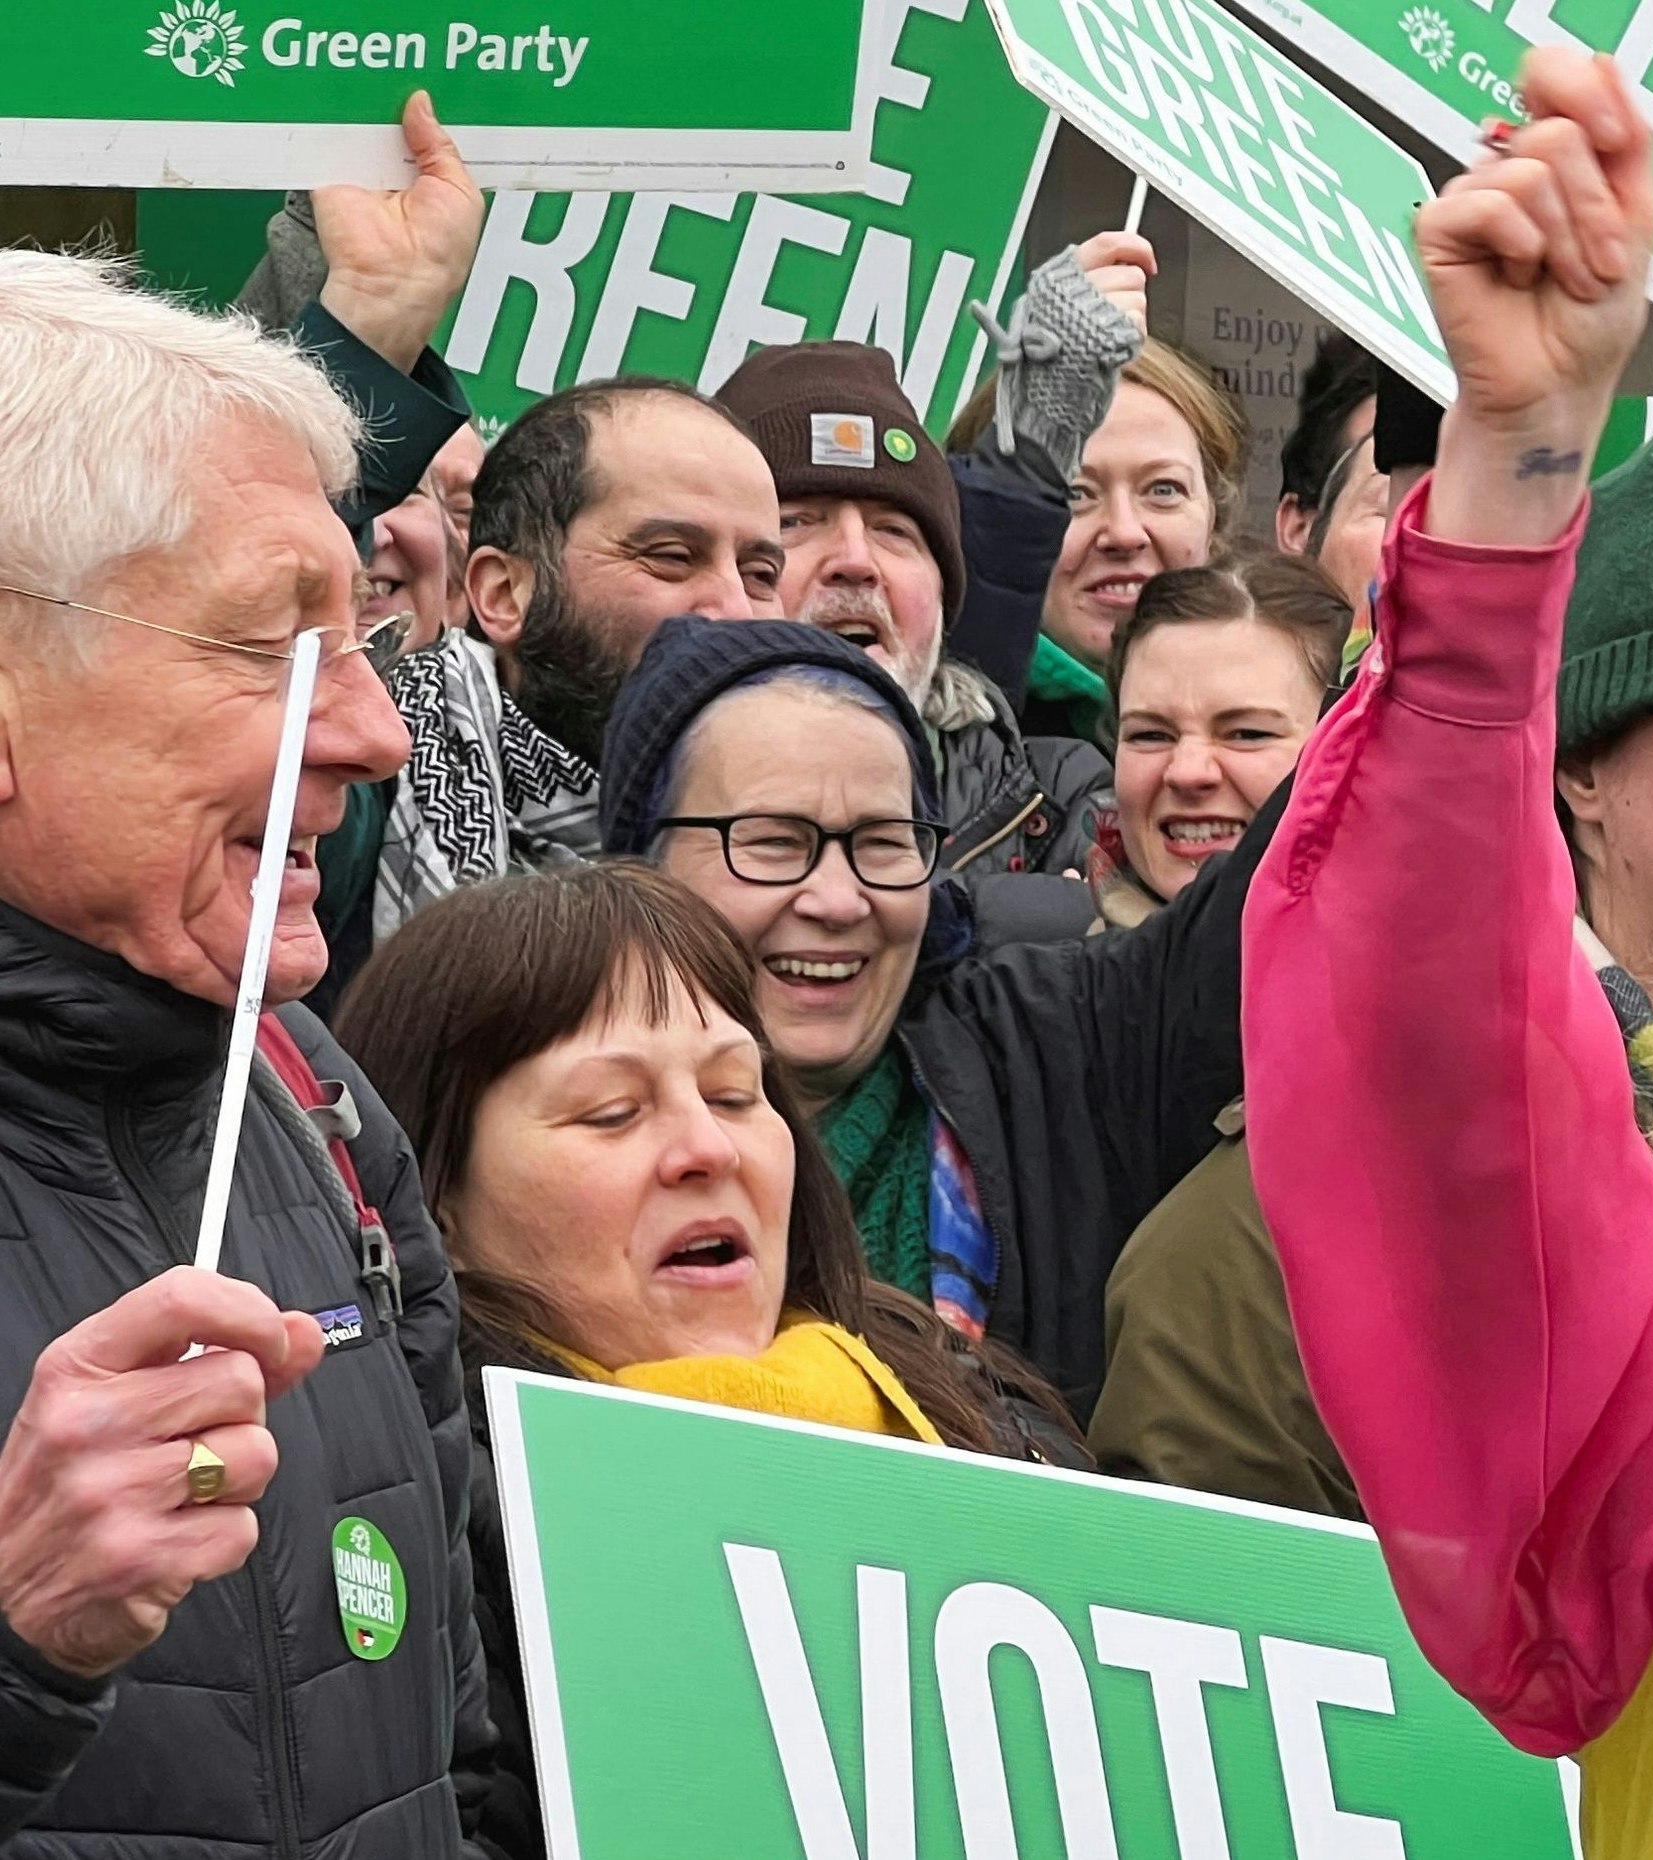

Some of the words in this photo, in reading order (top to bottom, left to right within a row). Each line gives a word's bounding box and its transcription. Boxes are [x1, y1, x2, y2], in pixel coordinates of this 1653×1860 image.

[262, 18, 427, 69] Green
[446, 22, 589, 88] Party
[1459, 51, 1534, 122] Gree
[1107, 0, 1342, 187] OTE
[1059, 0, 1450, 354] GREEN
[443, 190, 976, 424] REEN
[1213, 306, 1304, 356] Enjoy
[335, 1546, 391, 1593] HANNAH
[336, 1577, 394, 1625] SPENCER
[721, 1540, 1407, 1860] VOTE
